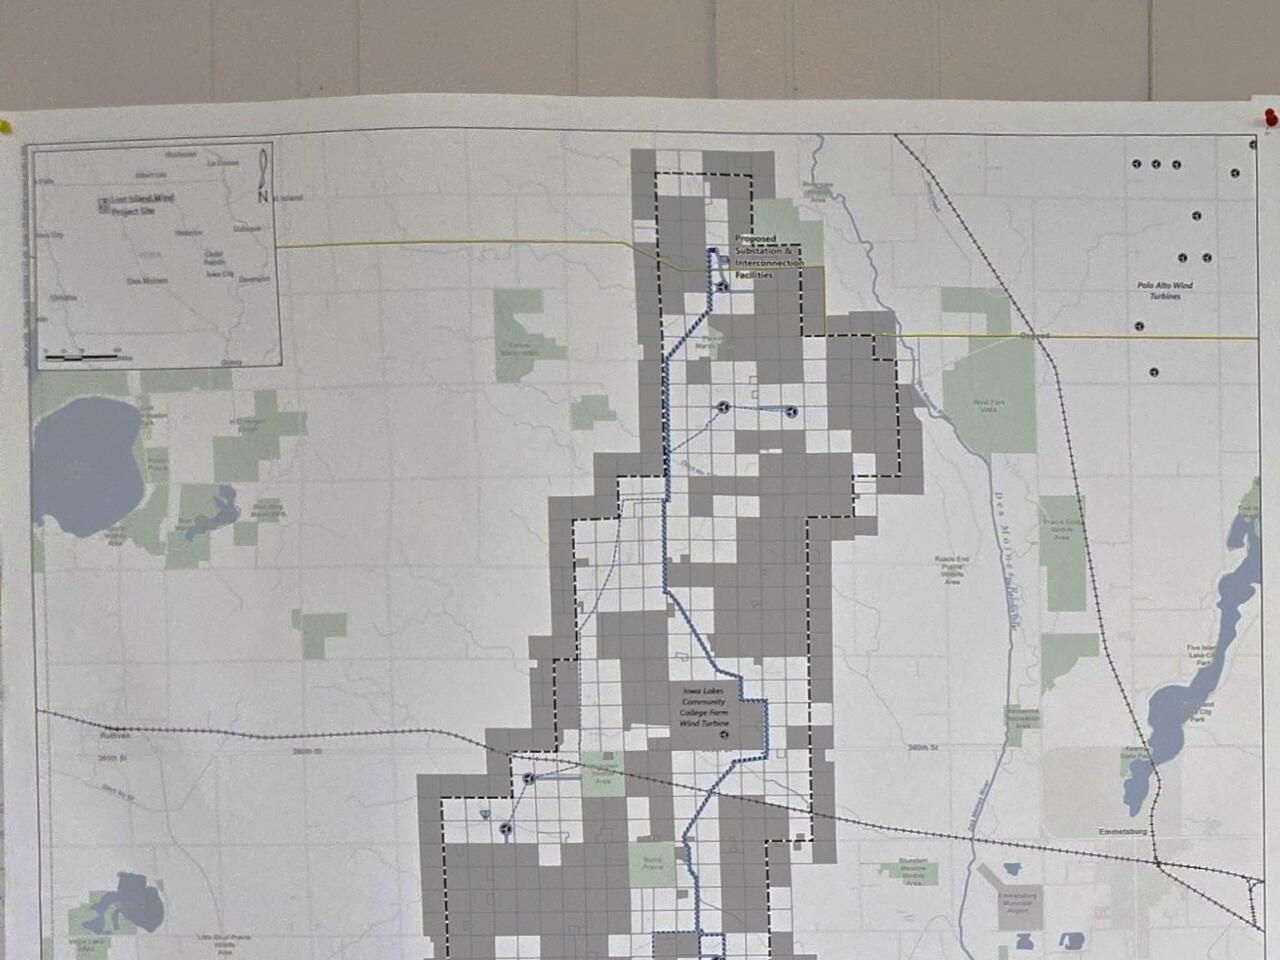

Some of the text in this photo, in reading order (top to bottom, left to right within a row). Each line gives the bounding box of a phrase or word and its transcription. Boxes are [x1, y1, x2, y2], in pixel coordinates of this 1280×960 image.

[735, 234, 777, 244] Proposed
[735, 258, 805, 268] Interconnection
[735, 271, 773, 280] Facilities
